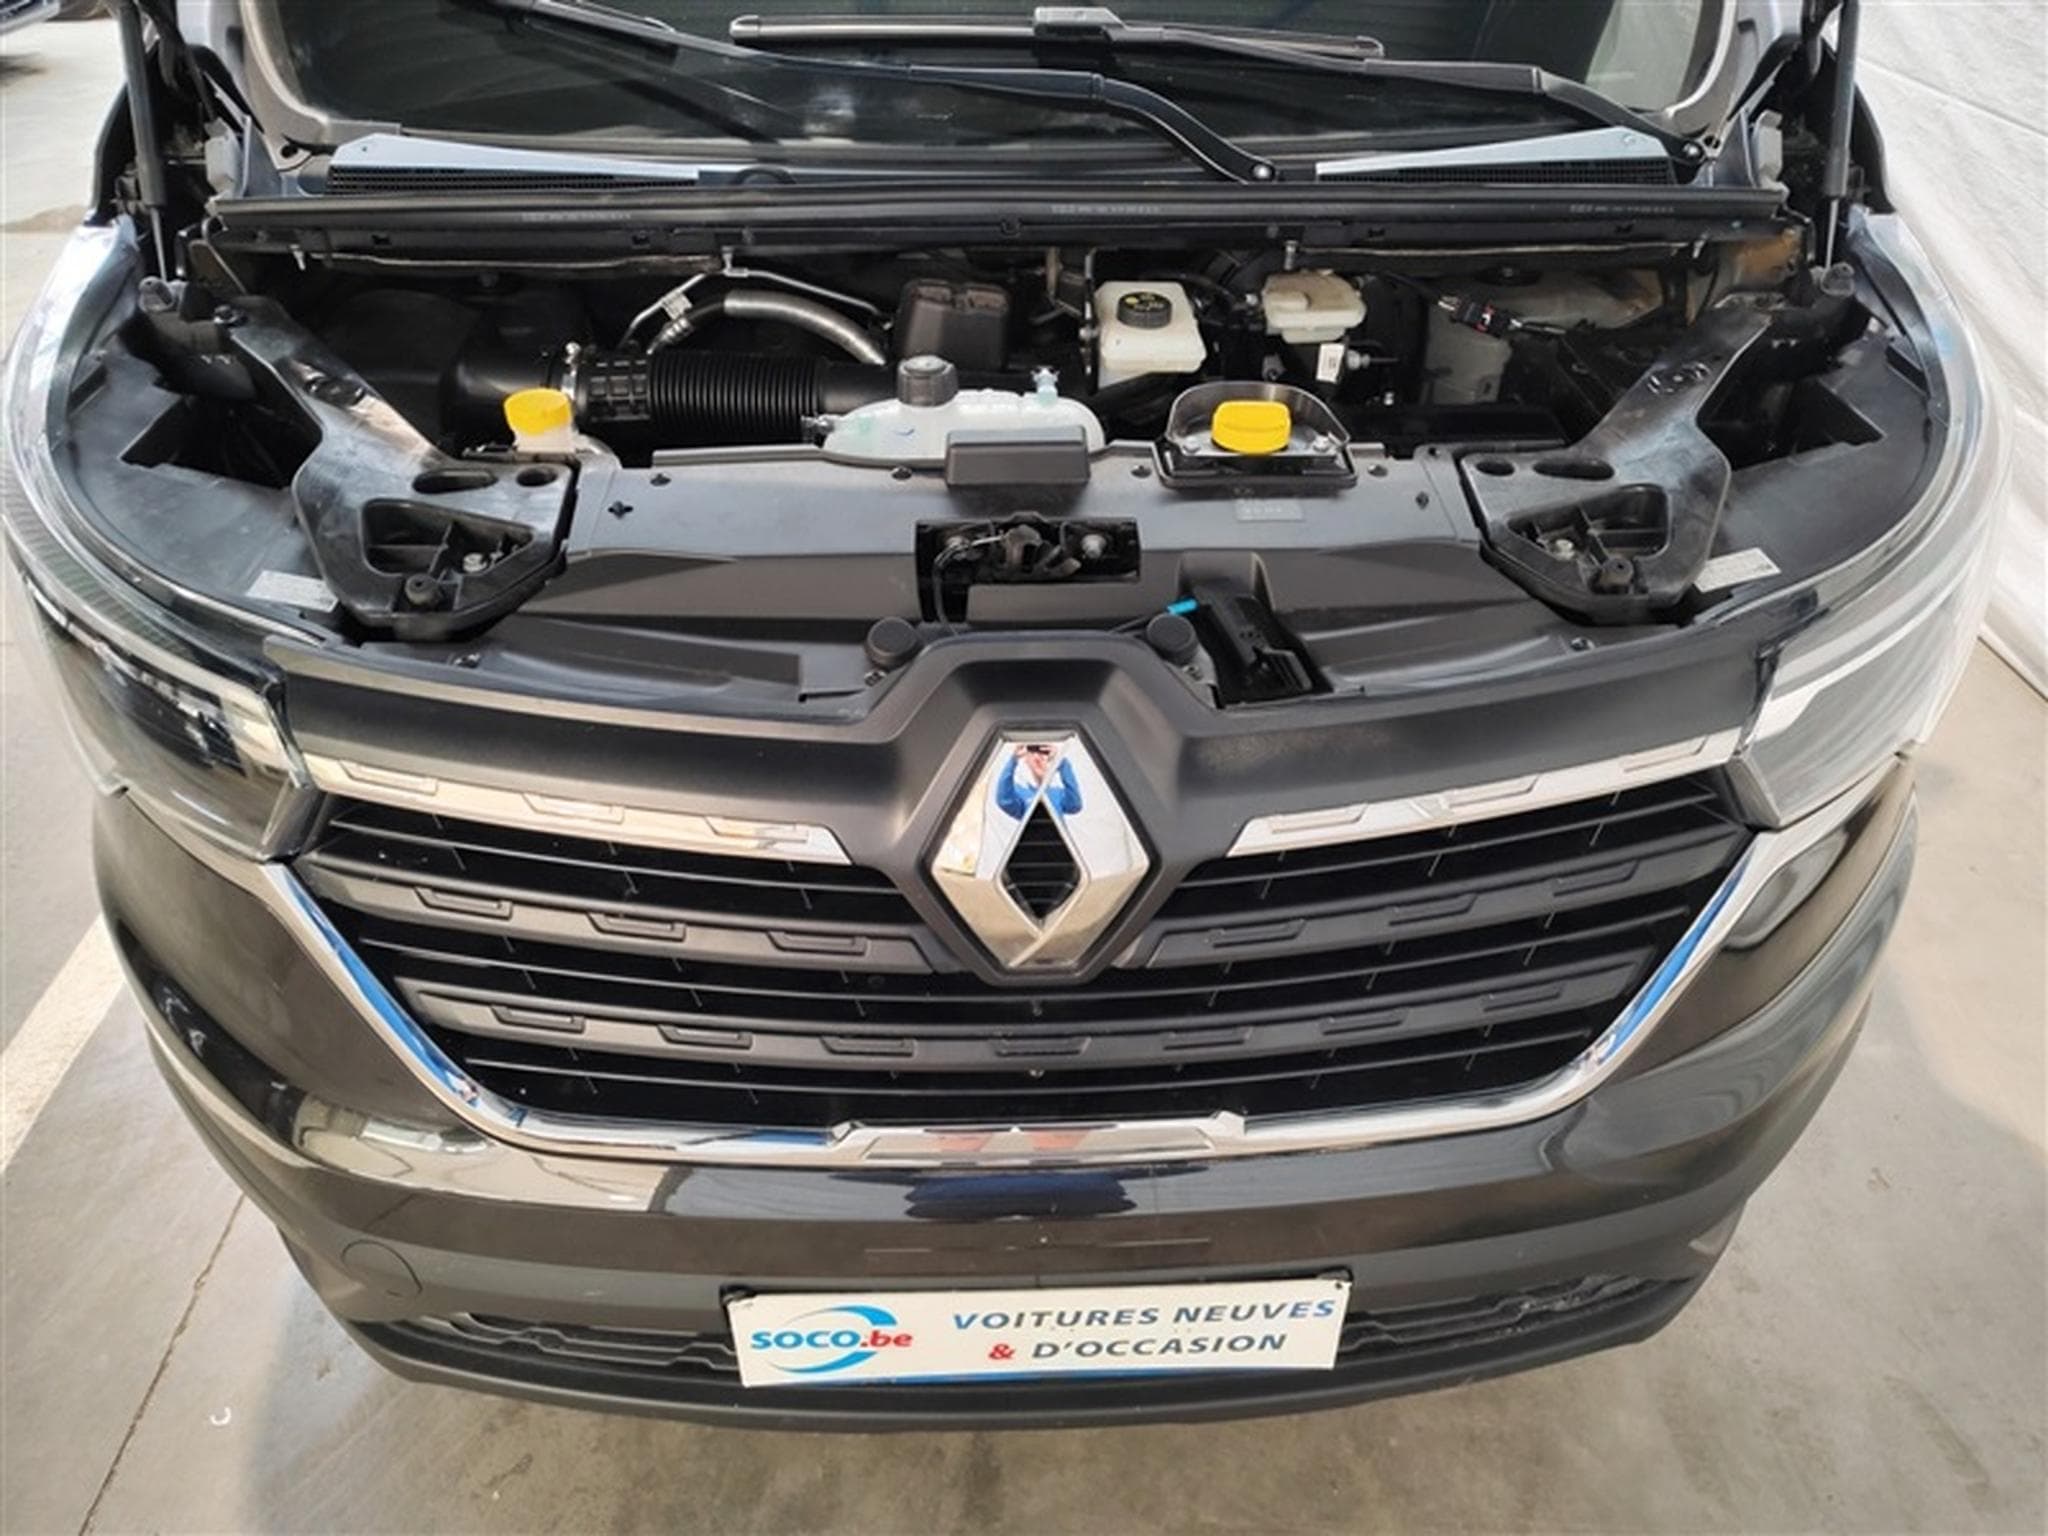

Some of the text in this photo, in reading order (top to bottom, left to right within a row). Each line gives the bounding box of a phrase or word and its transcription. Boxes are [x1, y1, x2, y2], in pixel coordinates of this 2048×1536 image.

[954, 1300, 1335, 1330] VOITURES NEUVES
[750, 1329, 913, 1350] SOCO.be
[988, 1334, 1287, 1361] & D'OCCASION
